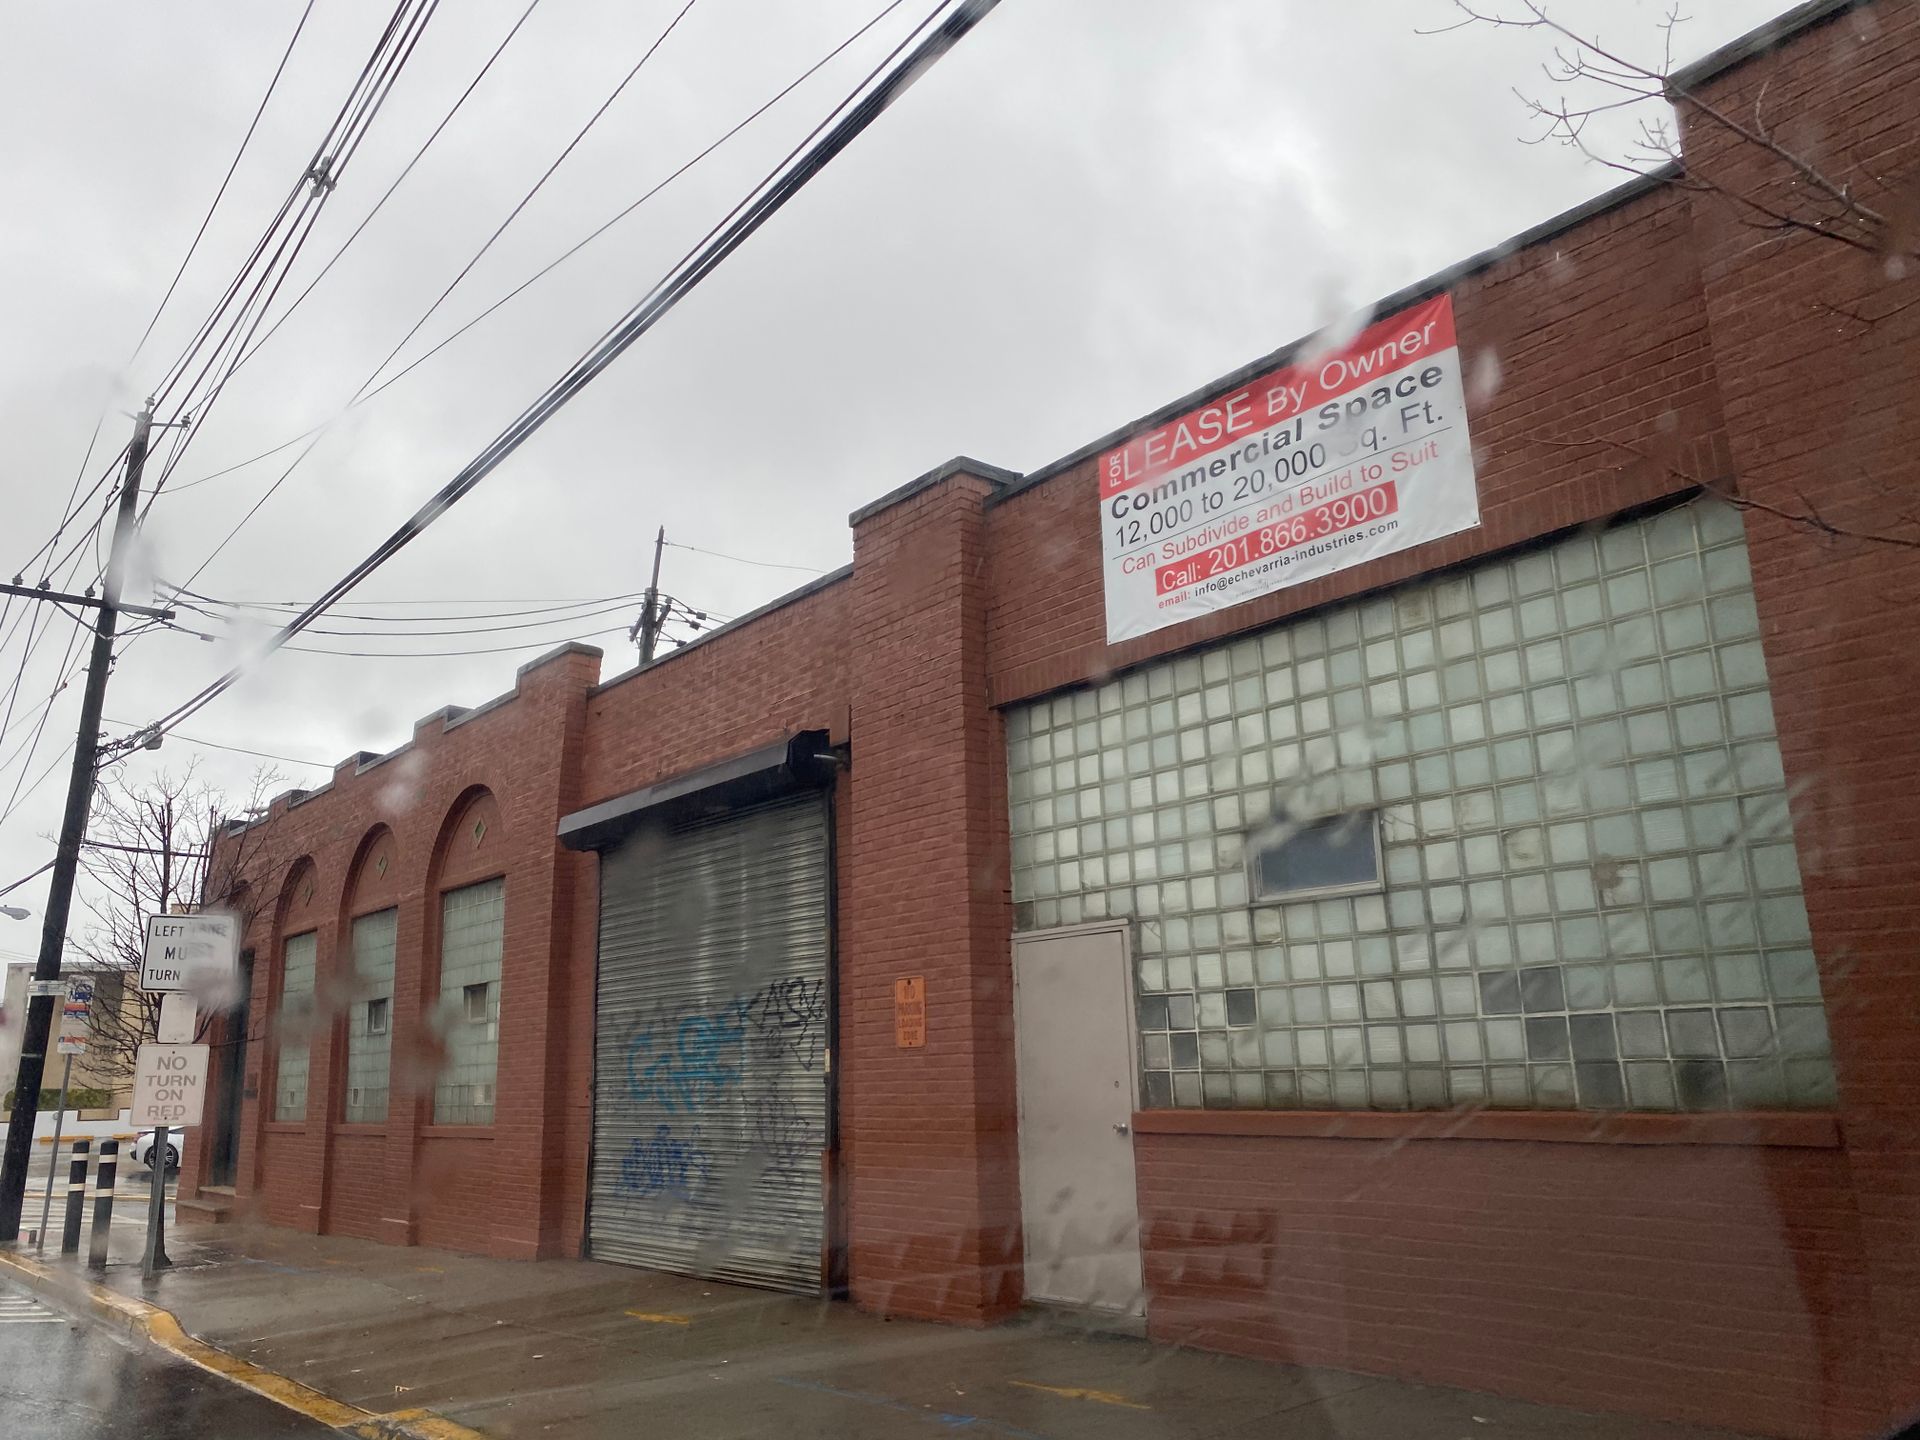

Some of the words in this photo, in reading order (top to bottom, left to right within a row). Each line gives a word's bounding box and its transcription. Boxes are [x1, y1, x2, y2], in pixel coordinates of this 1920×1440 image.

[1122, 393, 1254, 481] LEASE
[1266, 381, 1307, 416] By
[1319, 321, 1436, 390] Owner
[1111, 417, 1303, 519] Commercial
[1318, 366, 1443, 431] Space
[1109, 453, 1121, 488] FOR
[1115, 499, 1193, 548] 12,000
[1202, 491, 1224, 514] to
[1233, 442, 1326, 501] 20,000
[1400, 400, 1443, 433] Ft.
[1122, 552, 1156, 575] Can
[1162, 516, 1250, 560] Subdivide
[1256, 494, 1293, 523] and
[1300, 469, 1352, 507] Build
[1360, 463, 1383, 483] to
[1391, 440, 1439, 472] Suit
[1162, 562, 1201, 590] Call:
[1208, 488, 1388, 575] 201.866.3900
[1158, 590, 1191, 609] email:
[1195, 519, 1399, 597] info@echevarria-industries.com
[155, 925, 185, 937] LEFT
[148, 968, 181, 981] TURN
[145, 1075, 197, 1087] TURN
[157, 1056, 188, 1071] NO
[147, 1104, 186, 1117] RED
[154, 1089, 184, 1101] ON
